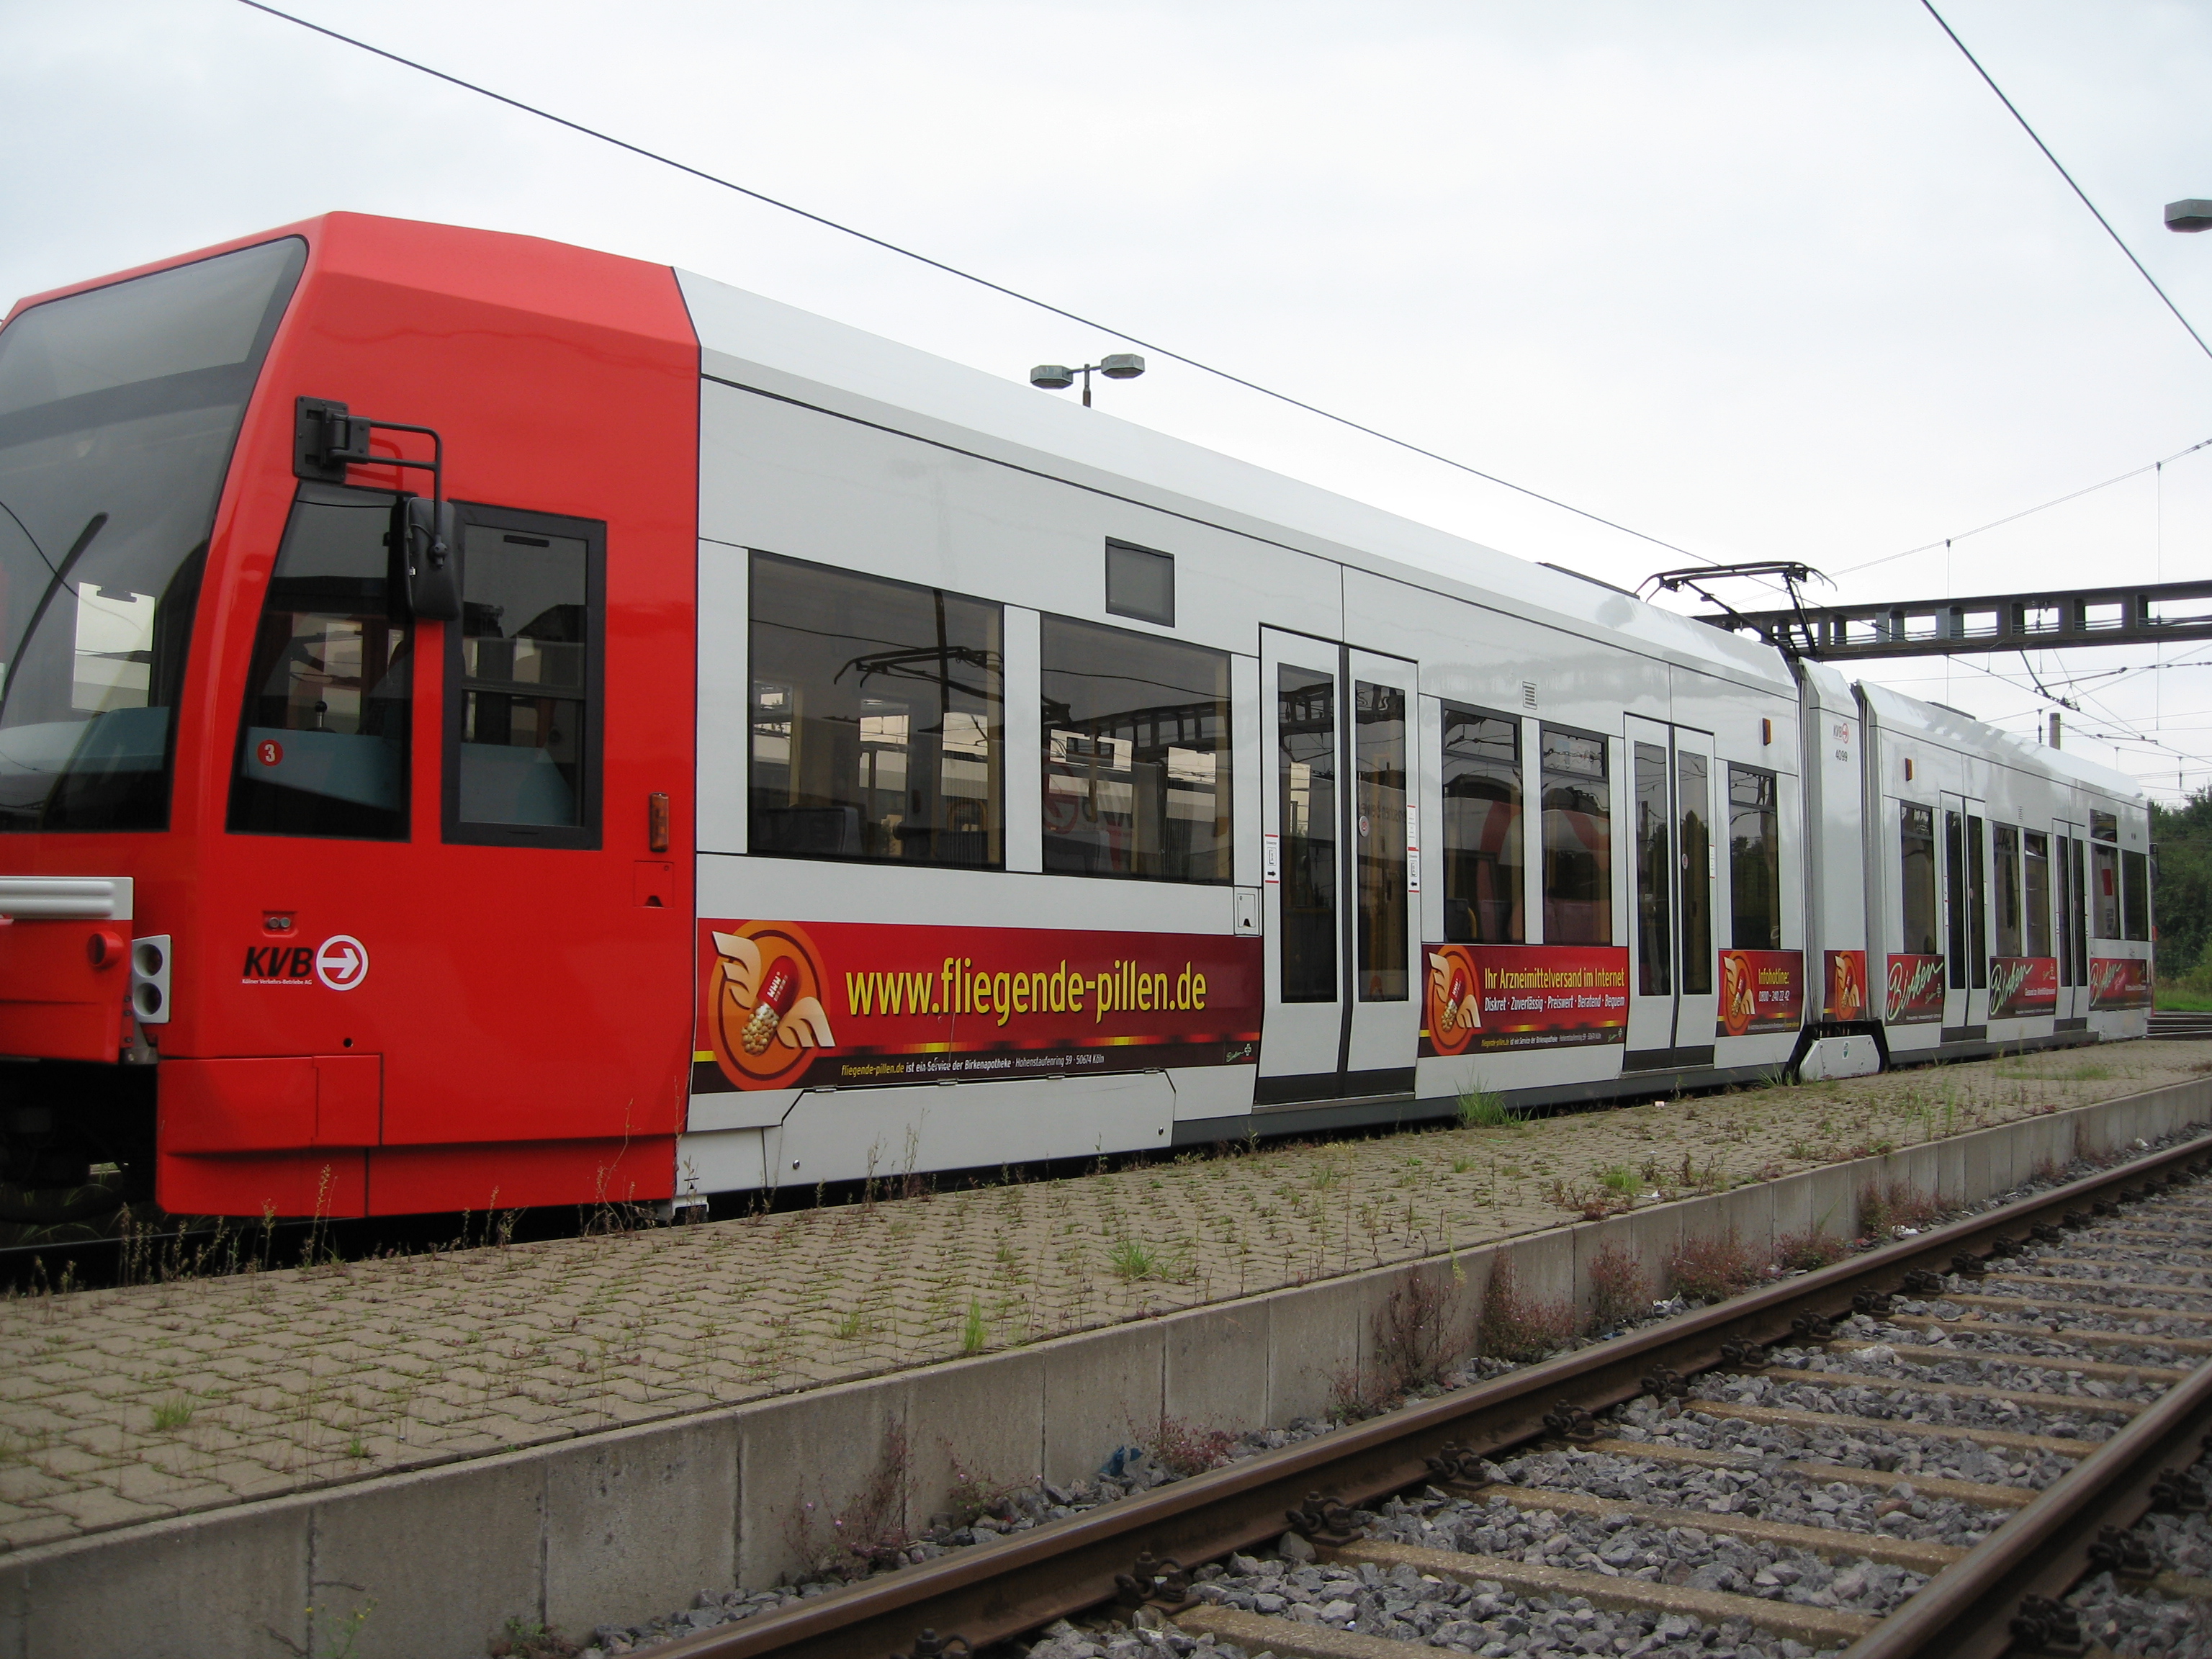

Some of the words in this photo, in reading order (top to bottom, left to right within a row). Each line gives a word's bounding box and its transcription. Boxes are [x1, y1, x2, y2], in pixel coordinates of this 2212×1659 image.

[264, 744, 276, 763] 3
[243, 946, 314, 978] KVB
[1484, 967, 1498, 989] Ihr
[1499, 967, 1583, 989] Arzneimittelversand
[1583, 967, 1593, 987] im
[1595, 967, 1625, 987] Internet
[845, 957, 1208, 1027] www.fliegende-pillen.de
[1485, 997, 1506, 1012] Diskret
[840, 1062, 905, 1078] fliegende-pillen.de
[905, 1061, 914, 1074] ist
[915, 1060, 926, 1073] ein
[927, 1059, 951, 1072] Service
[952, 1058, 963, 1071] der
[964, 1057, 1012, 1071] Birkenapotheke
[1092, 1053, 1105, 1064] Köln
